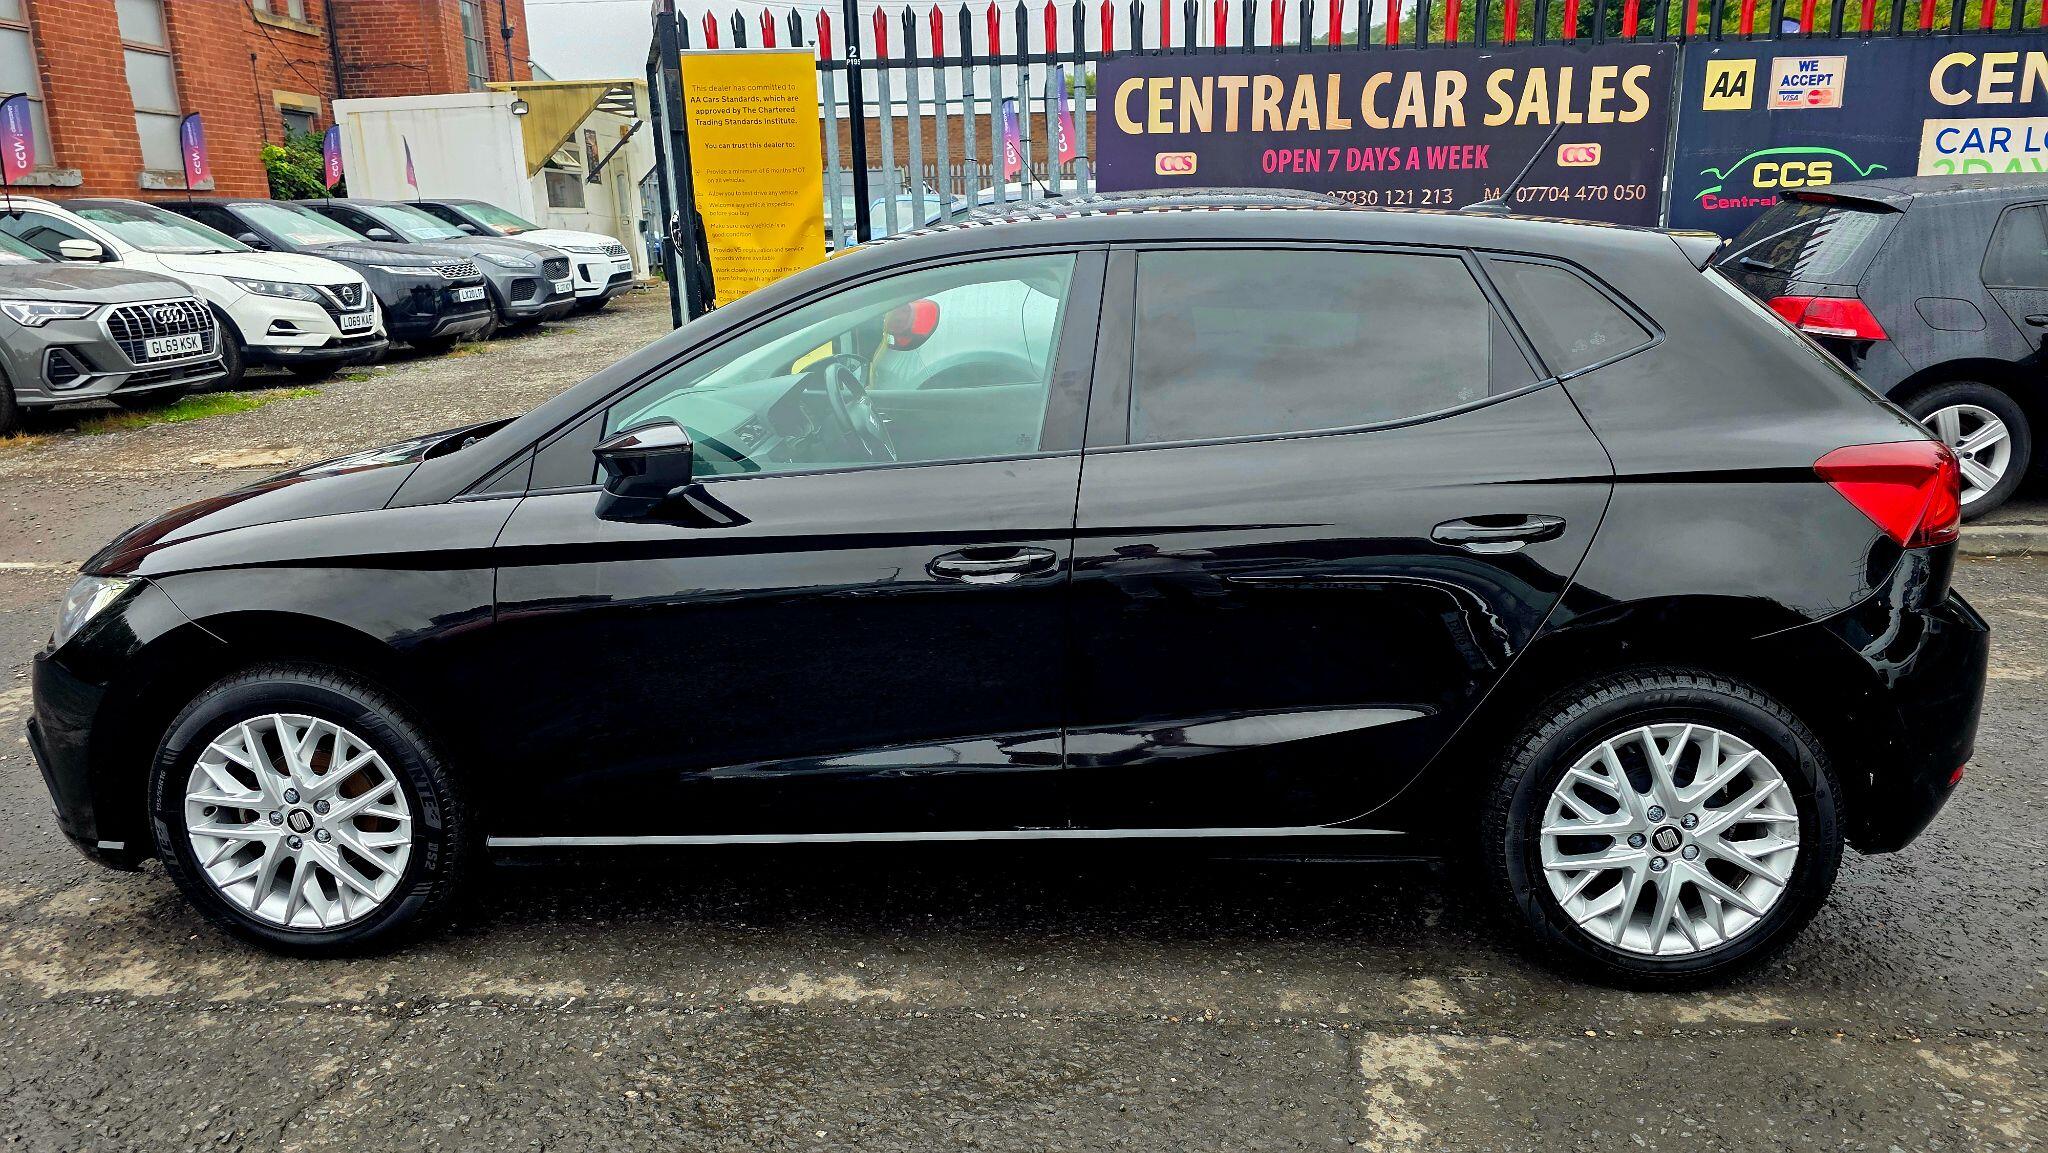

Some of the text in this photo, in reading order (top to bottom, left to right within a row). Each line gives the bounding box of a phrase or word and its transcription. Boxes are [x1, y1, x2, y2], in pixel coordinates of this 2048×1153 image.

[849, 46, 857, 57] 2
[1798, 60, 1819, 72] WE
[709, 84, 731, 92] dealer
[1710, 70, 1747, 98] AA
[1781, 74, 1833, 86] ACCEPT
[1114, 65, 1652, 134] CENTRAL CAR SALES
[732, 107, 741, 115] by
[1936, 126, 2048, 154] CAR L
[1160, 155, 1192, 172] CCS
[1262, 144, 1490, 173] OPEN 7 DAYS A WEEK
[1562, 147, 1596, 163] CCS
[1753, 161, 1832, 188] CCS
[1385, 188, 1414, 205] 121
[1421, 188, 1453, 204] 213
[1516, 186, 1569, 202] 07704
[1574, 186, 1608, 201] 470
[1614, 184, 1646, 200] 050
[1702, 194, 1777, 210] Central
[344, 314, 373, 327] LO69 KAE
[152, 336, 198, 354] GL69 KSK
